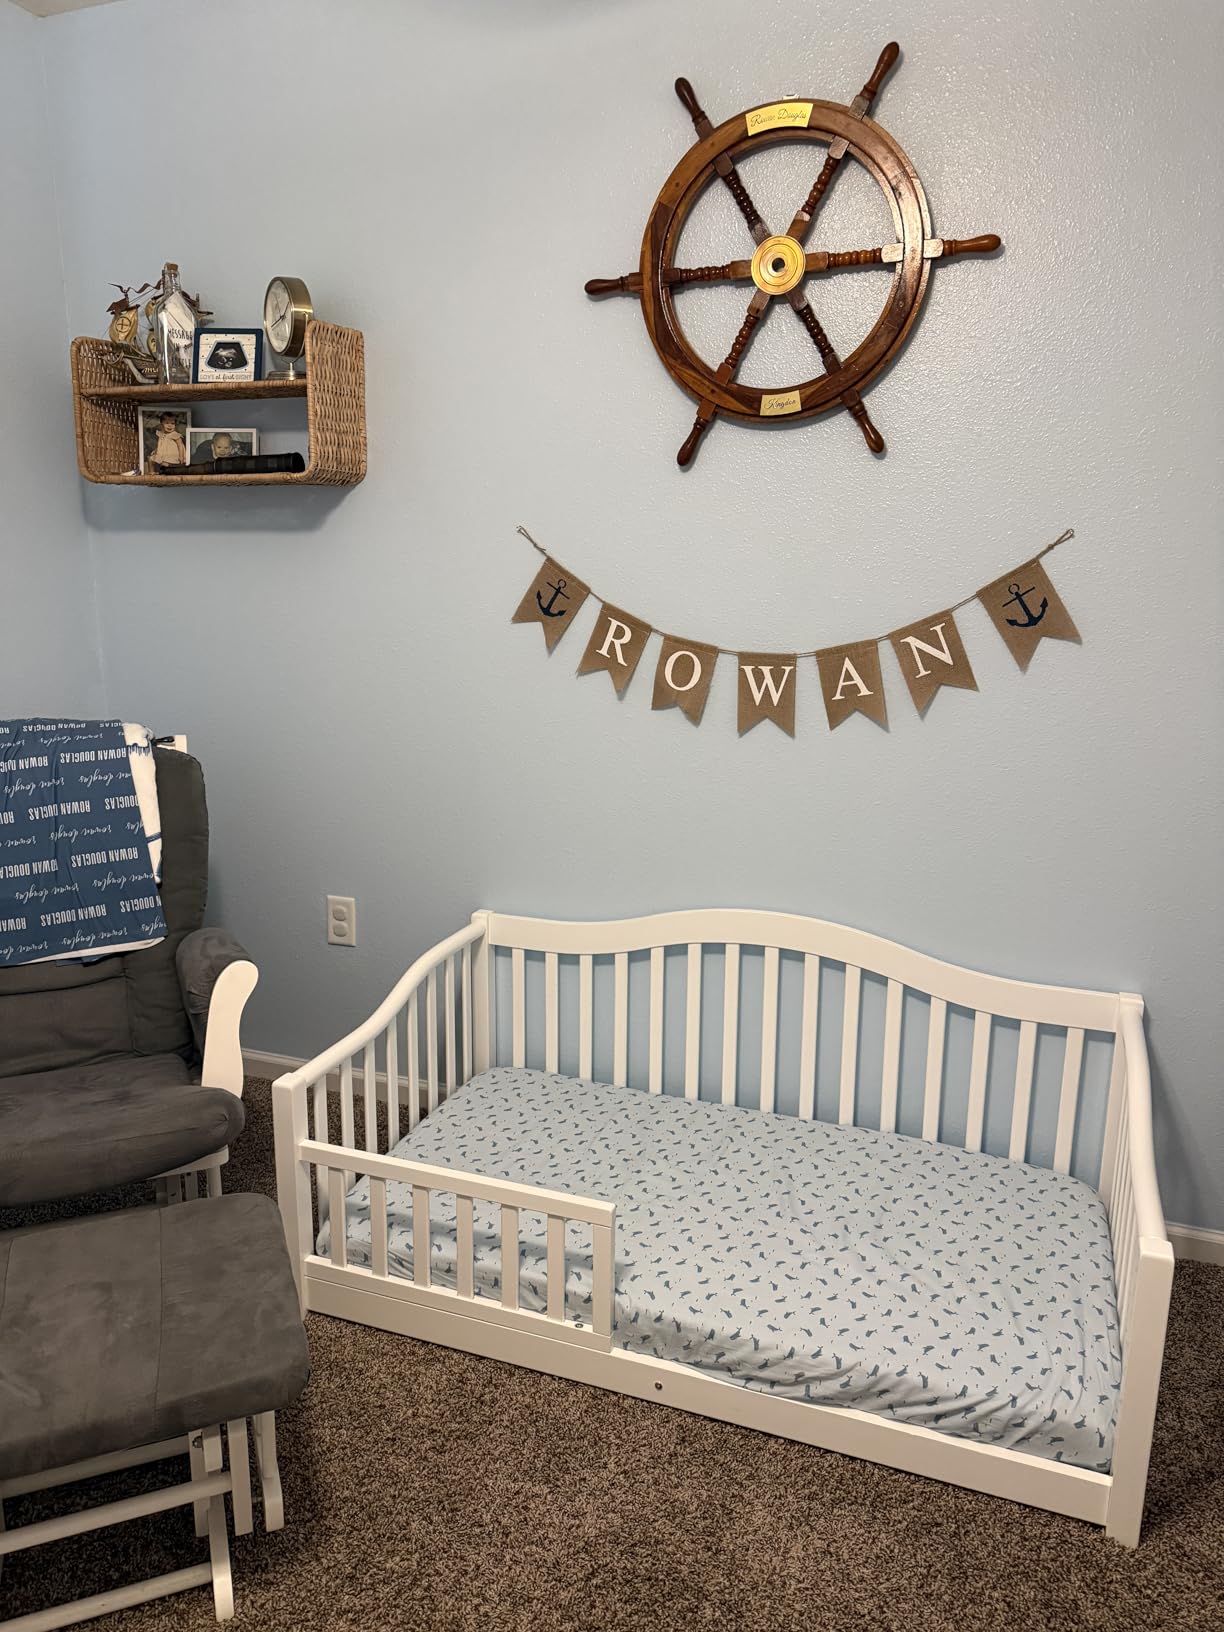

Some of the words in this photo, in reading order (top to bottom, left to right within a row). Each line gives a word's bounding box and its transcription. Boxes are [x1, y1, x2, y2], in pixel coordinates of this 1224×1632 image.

[777, 108, 807, 122] Douglas
[596, 617, 957, 707] ROWAN
[60, 750, 95, 764] DOUGLAS
[97, 747, 127, 761] ROWAN
[18, 755, 49, 770] ROWAN
[79, 768, 114, 788] douglas
[3, 778, 36, 798] dougls
[60, 800, 91, 815] ROWAN
[49, 824, 79, 843] dougls
[80, 824, 112, 837] rowan
[4, 835, 37, 848] rowan
[70, 854, 107, 868] DOUGLAS
[109, 847, 139, 862] ROWAN
[0, 863, 30, 879] DOUGLA
[128, 872, 154, 882] owan
[92, 871, 127, 891] douglas
[14, 883, 49, 904] douglas
[78, 903, 107, 919] ROWAN
[119, 897, 156, 913] DOUGLAS
[0, 917, 27, 932] ROWA
[40, 908, 77, 927] DOUGLAS
[141, 915, 167, 936] uglas
[61, 929, 97, 949] douglas
[98, 927, 128, 940] rowan
[18, 940, 48, 953] rowan
